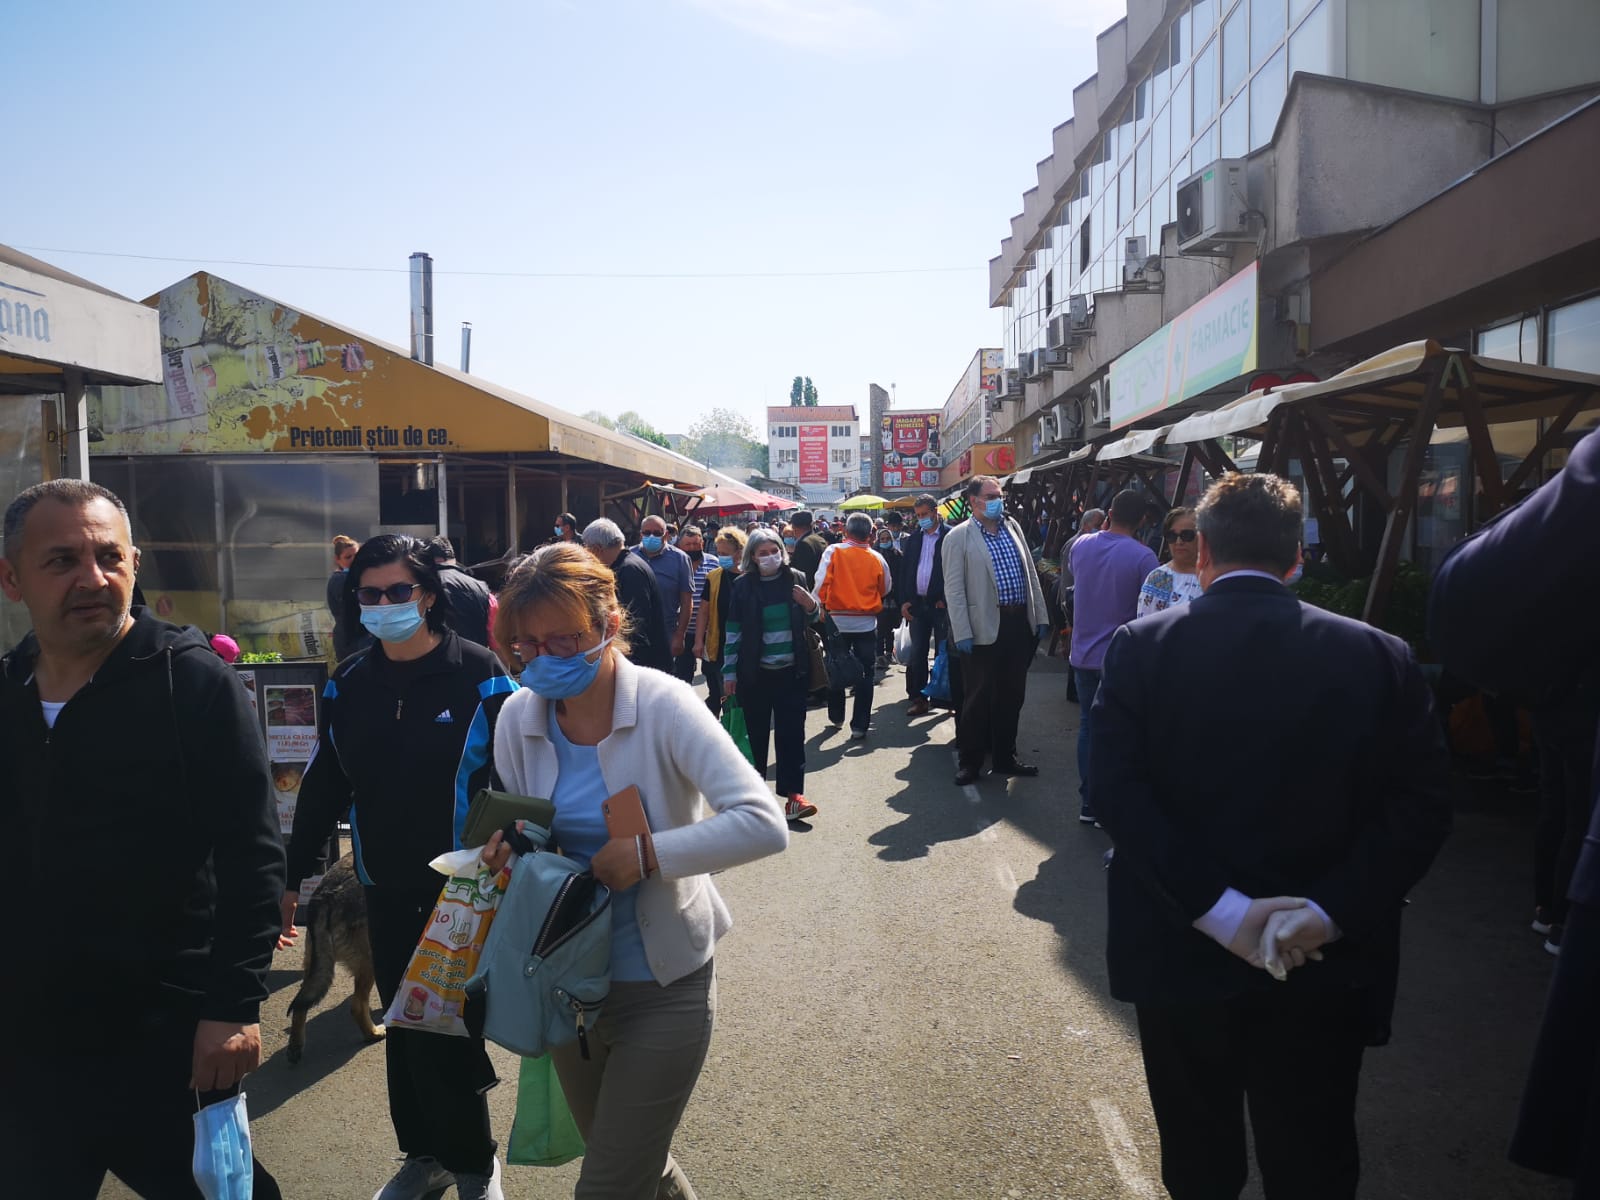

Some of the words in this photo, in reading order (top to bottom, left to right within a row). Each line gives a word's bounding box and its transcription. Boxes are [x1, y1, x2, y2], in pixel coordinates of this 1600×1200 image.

[1191, 297, 1249, 358] FARMACIE
[290, 426, 363, 447] Prietenii
[366, 426, 399, 450] știu
[402, 425, 423, 446] de
[427, 427, 454, 446] ce.
